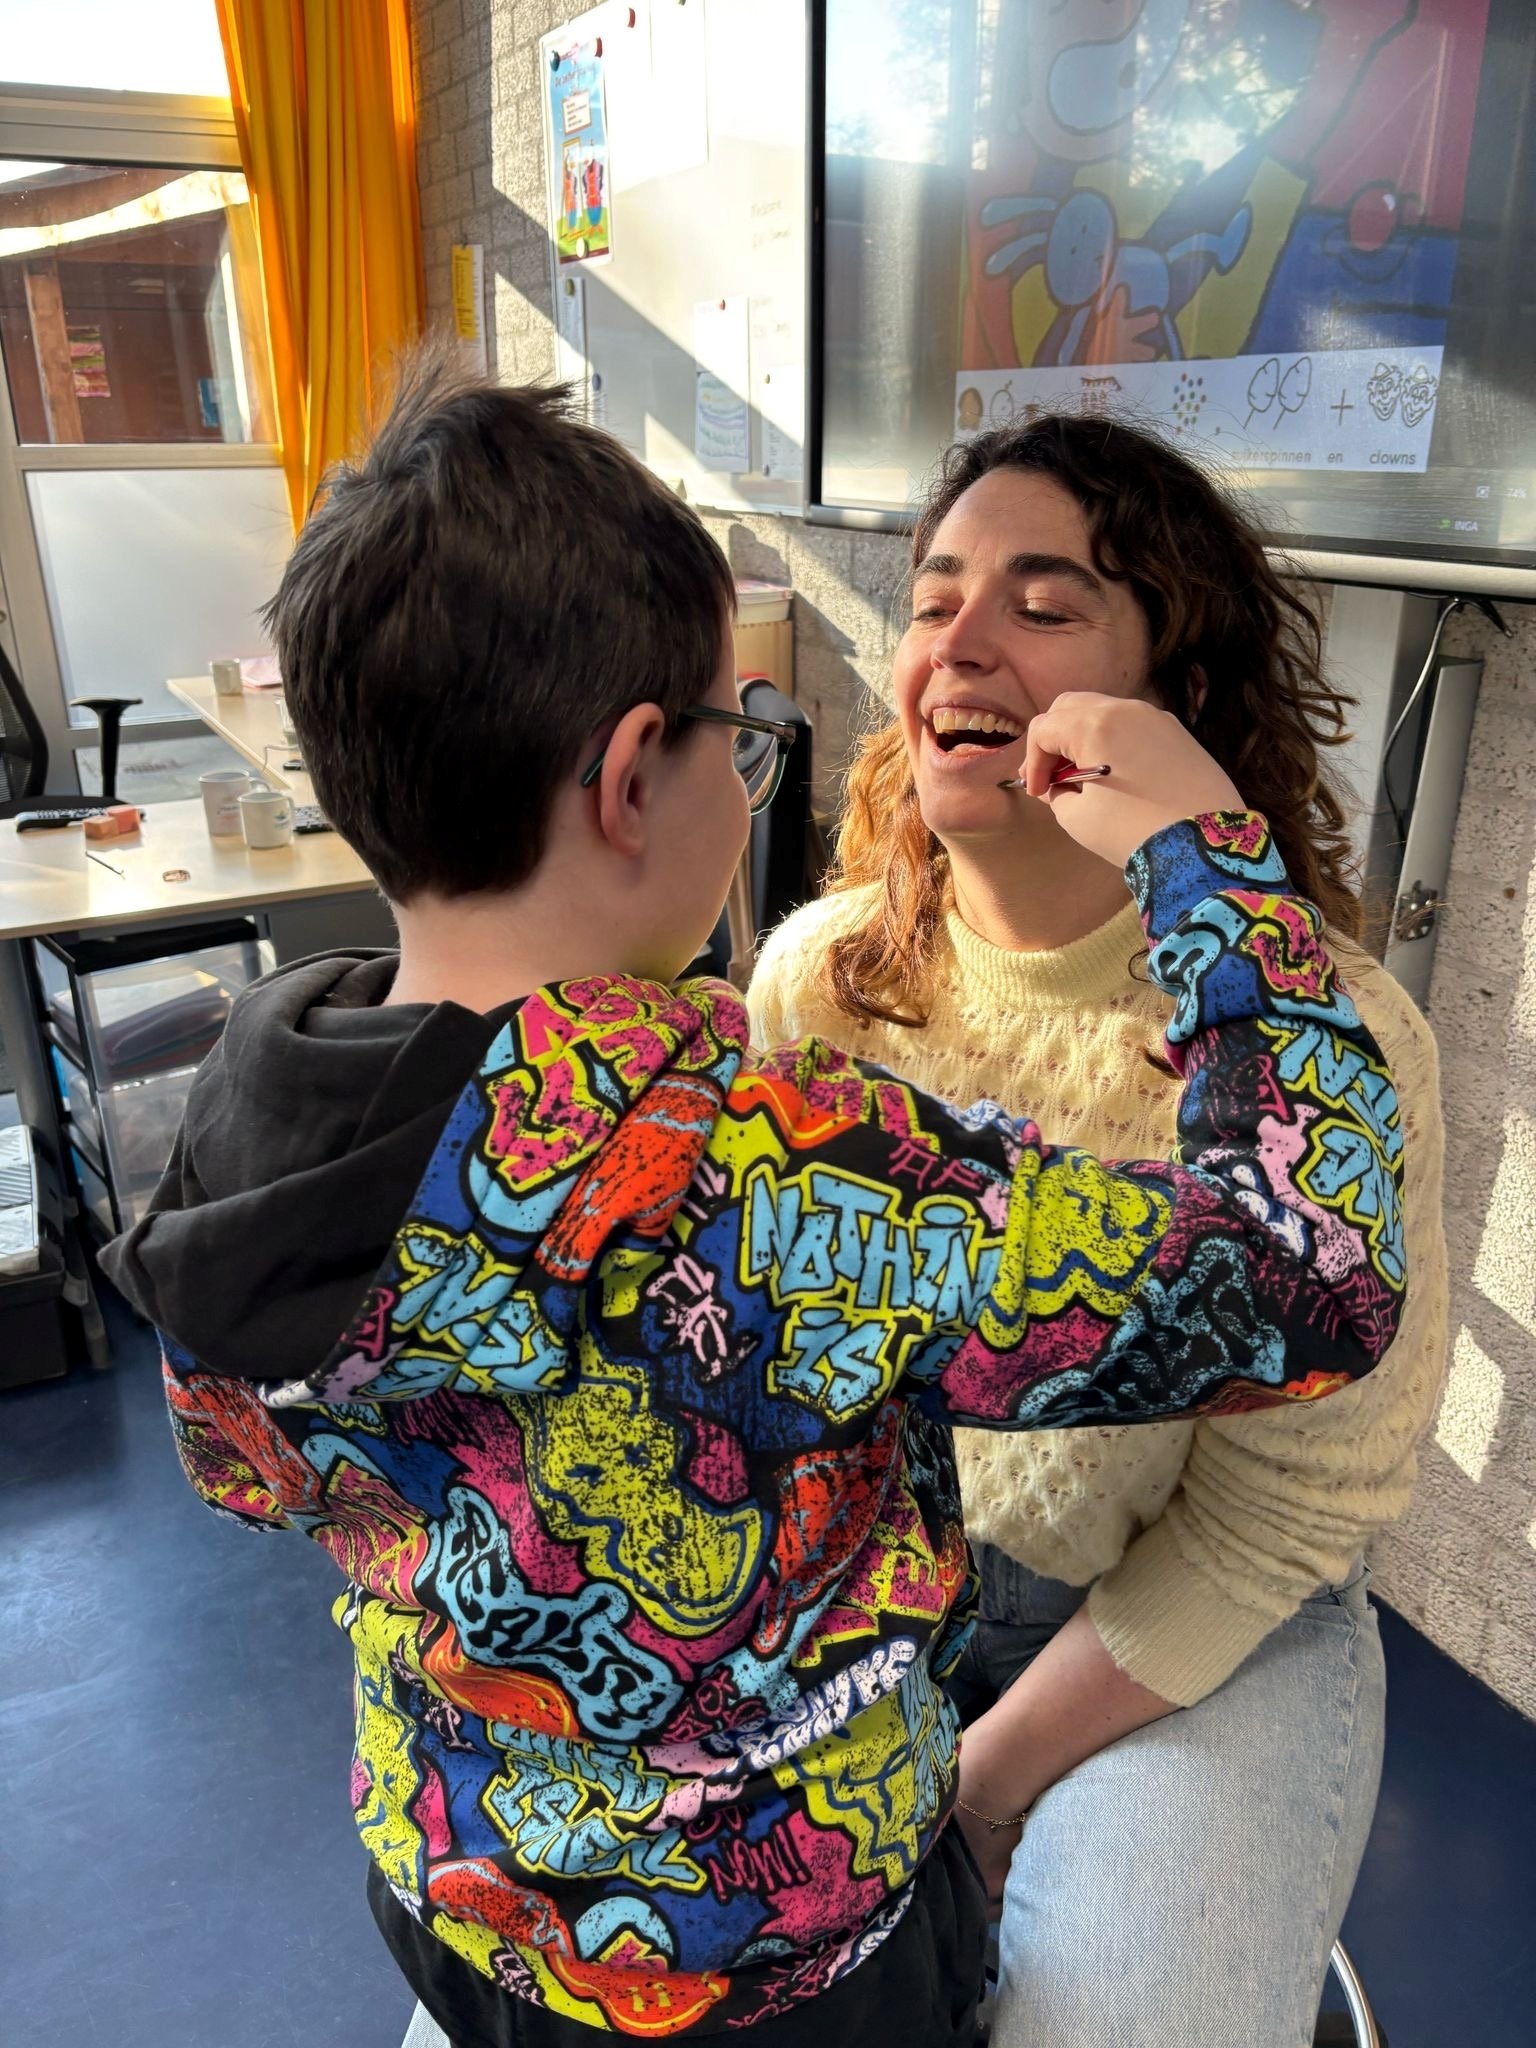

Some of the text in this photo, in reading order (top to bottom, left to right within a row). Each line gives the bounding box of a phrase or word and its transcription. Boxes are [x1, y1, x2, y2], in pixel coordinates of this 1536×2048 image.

[1327, 451, 1344, 464] en
[1368, 450, 1417, 466] clowns
[775, 1306, 892, 1413] IS
